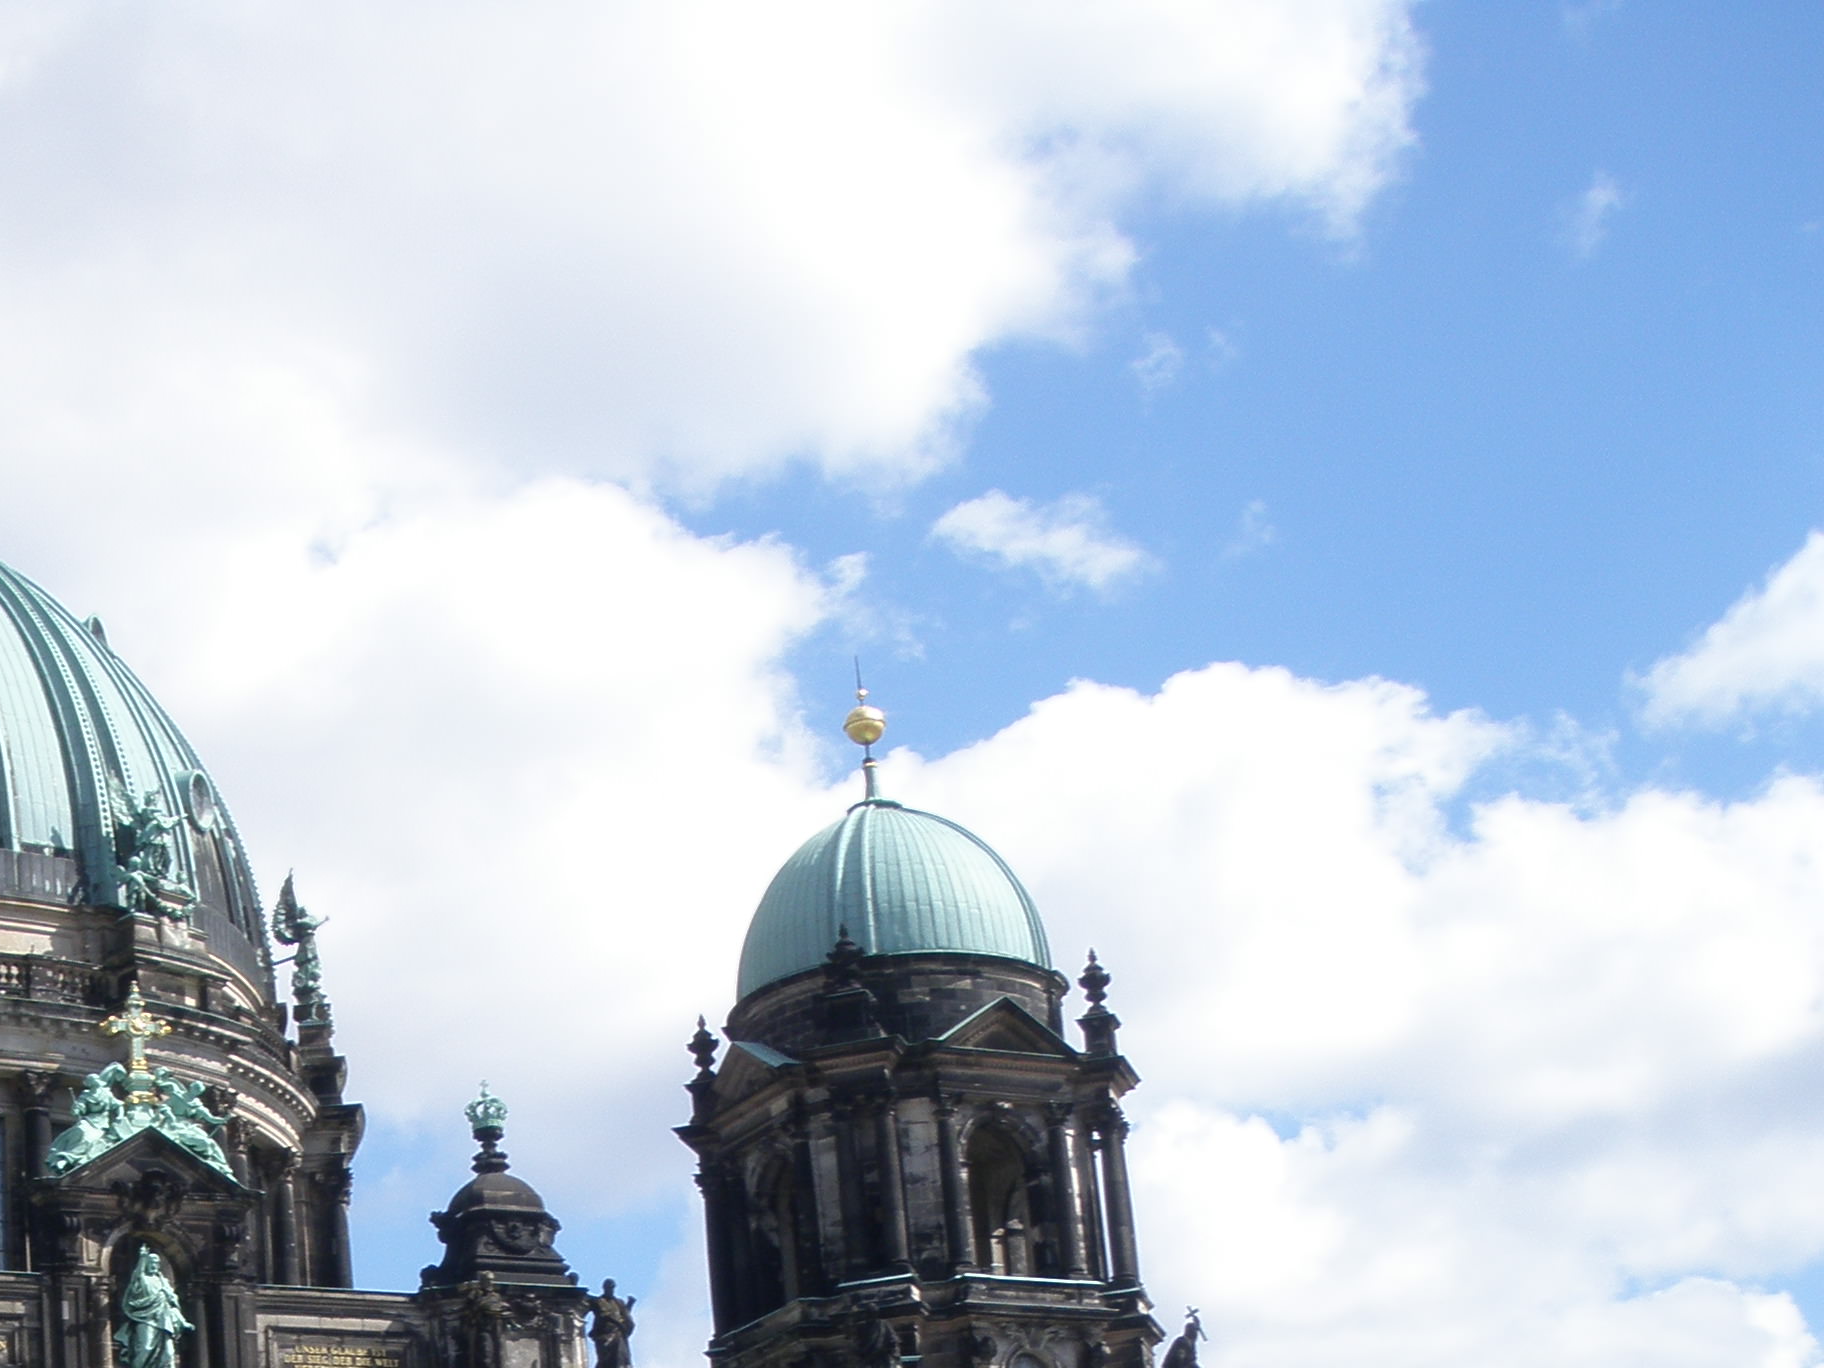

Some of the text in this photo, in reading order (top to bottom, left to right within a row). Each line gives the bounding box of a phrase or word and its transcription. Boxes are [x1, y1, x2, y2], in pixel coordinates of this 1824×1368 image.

[295, 1345, 328, 1355] UNSER
[283, 1354, 303, 1364] DER
[332, 1356, 353, 1365] DER
[355, 1357, 372, 1366] DIE
[374, 1358, 399, 1368] WELT
